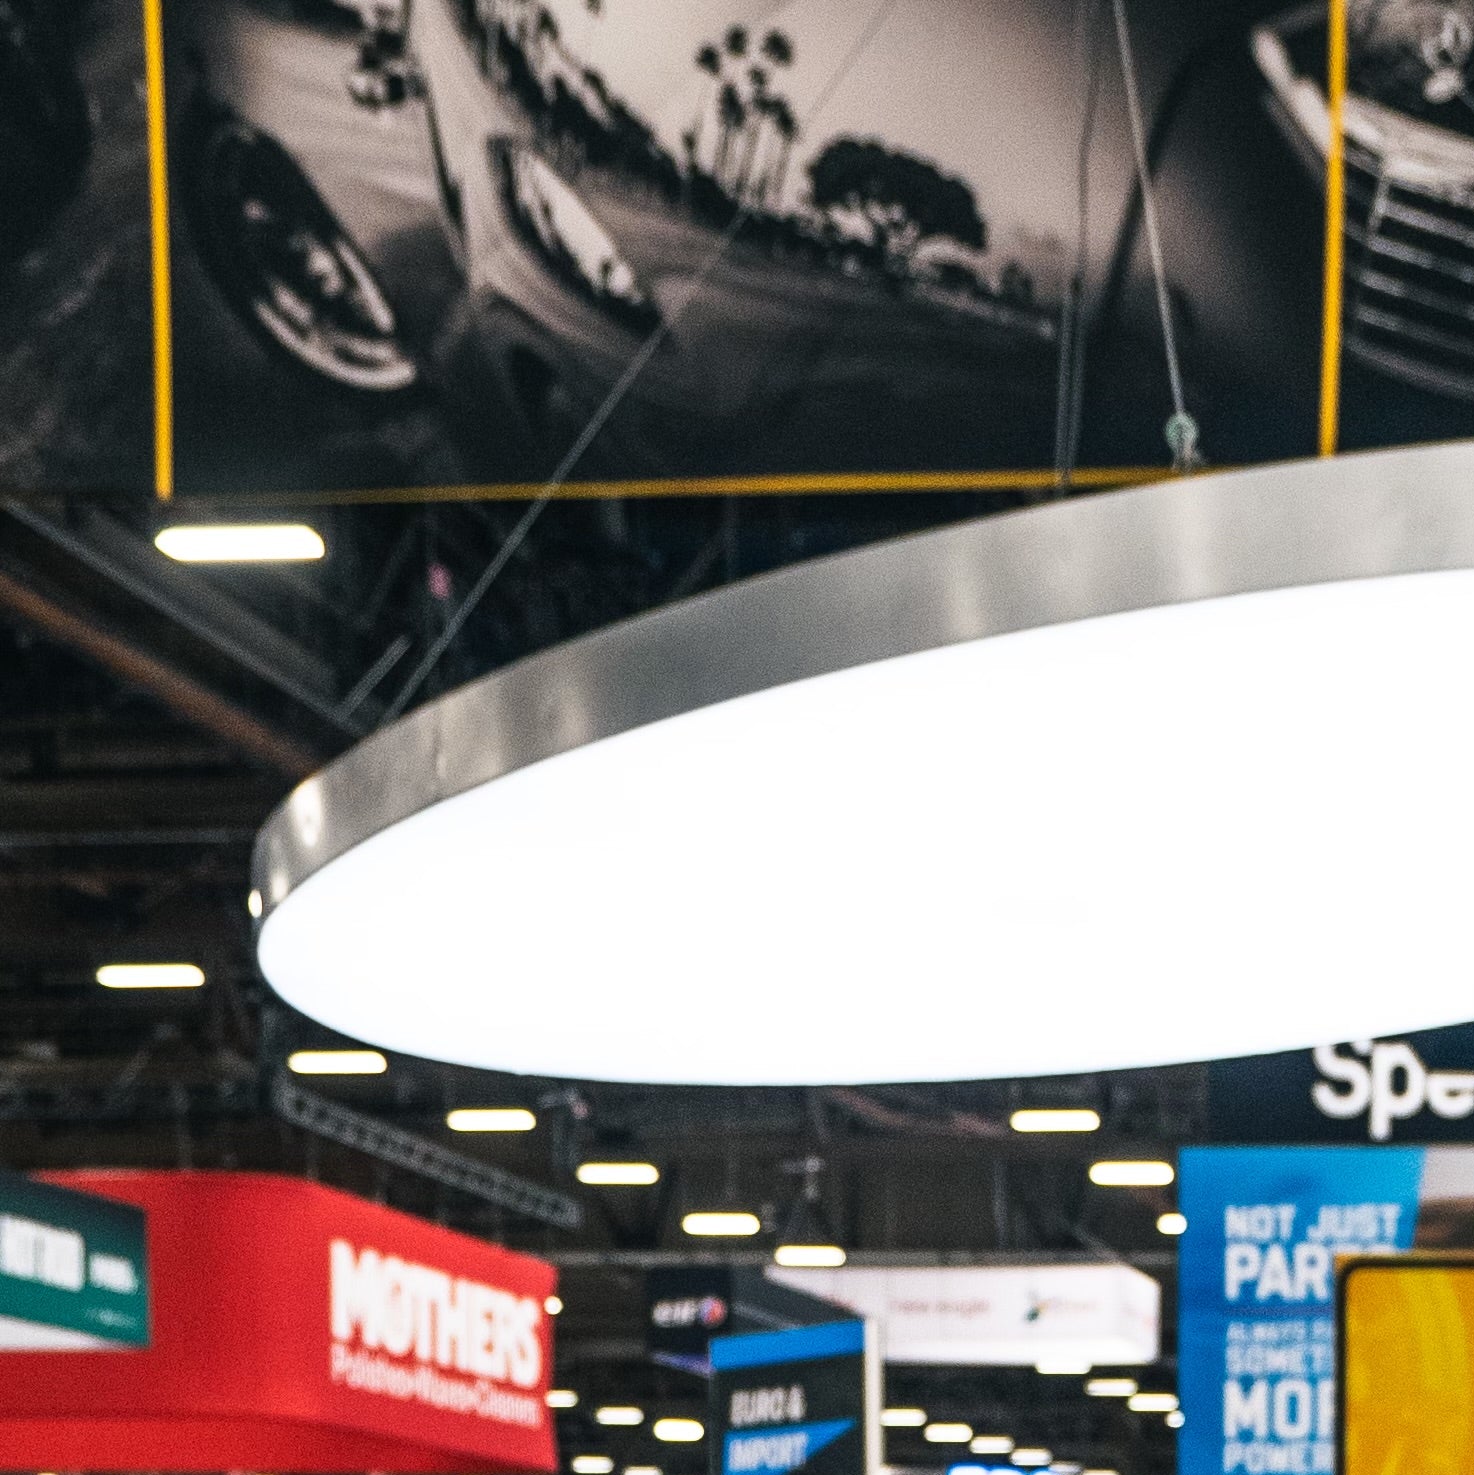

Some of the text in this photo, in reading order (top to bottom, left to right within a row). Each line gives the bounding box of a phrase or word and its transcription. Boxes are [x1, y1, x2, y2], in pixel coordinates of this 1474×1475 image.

[1225, 1203, 1401, 1242] NOT JUST
[329, 1238, 542, 1390] MOTHERS
